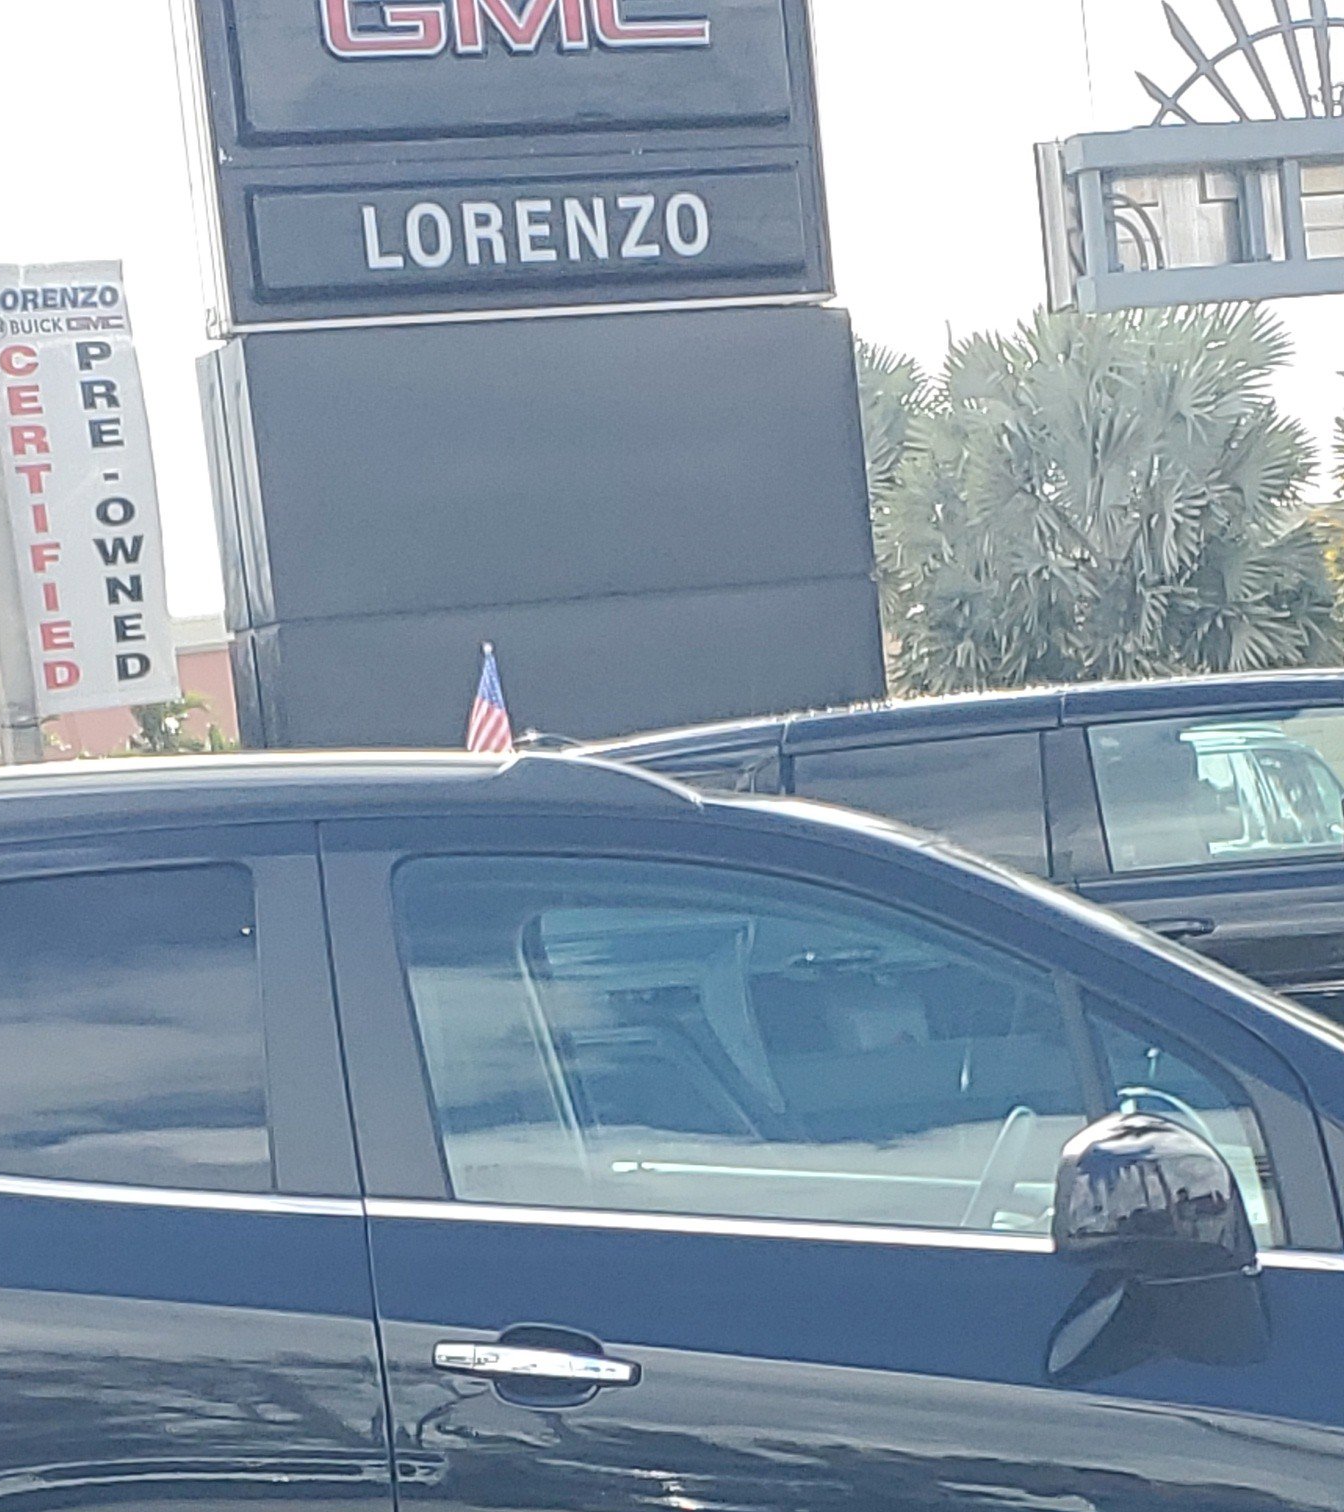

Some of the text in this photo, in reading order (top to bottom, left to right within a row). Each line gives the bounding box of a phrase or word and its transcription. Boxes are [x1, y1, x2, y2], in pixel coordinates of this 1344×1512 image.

[10, 316, 126, 335] BUICK GMC
[362, 192, 711, 270] LORENZO
[0, 344, 81, 691] CERTIFIED
[75, 341, 152, 682] PRE-OWNED
